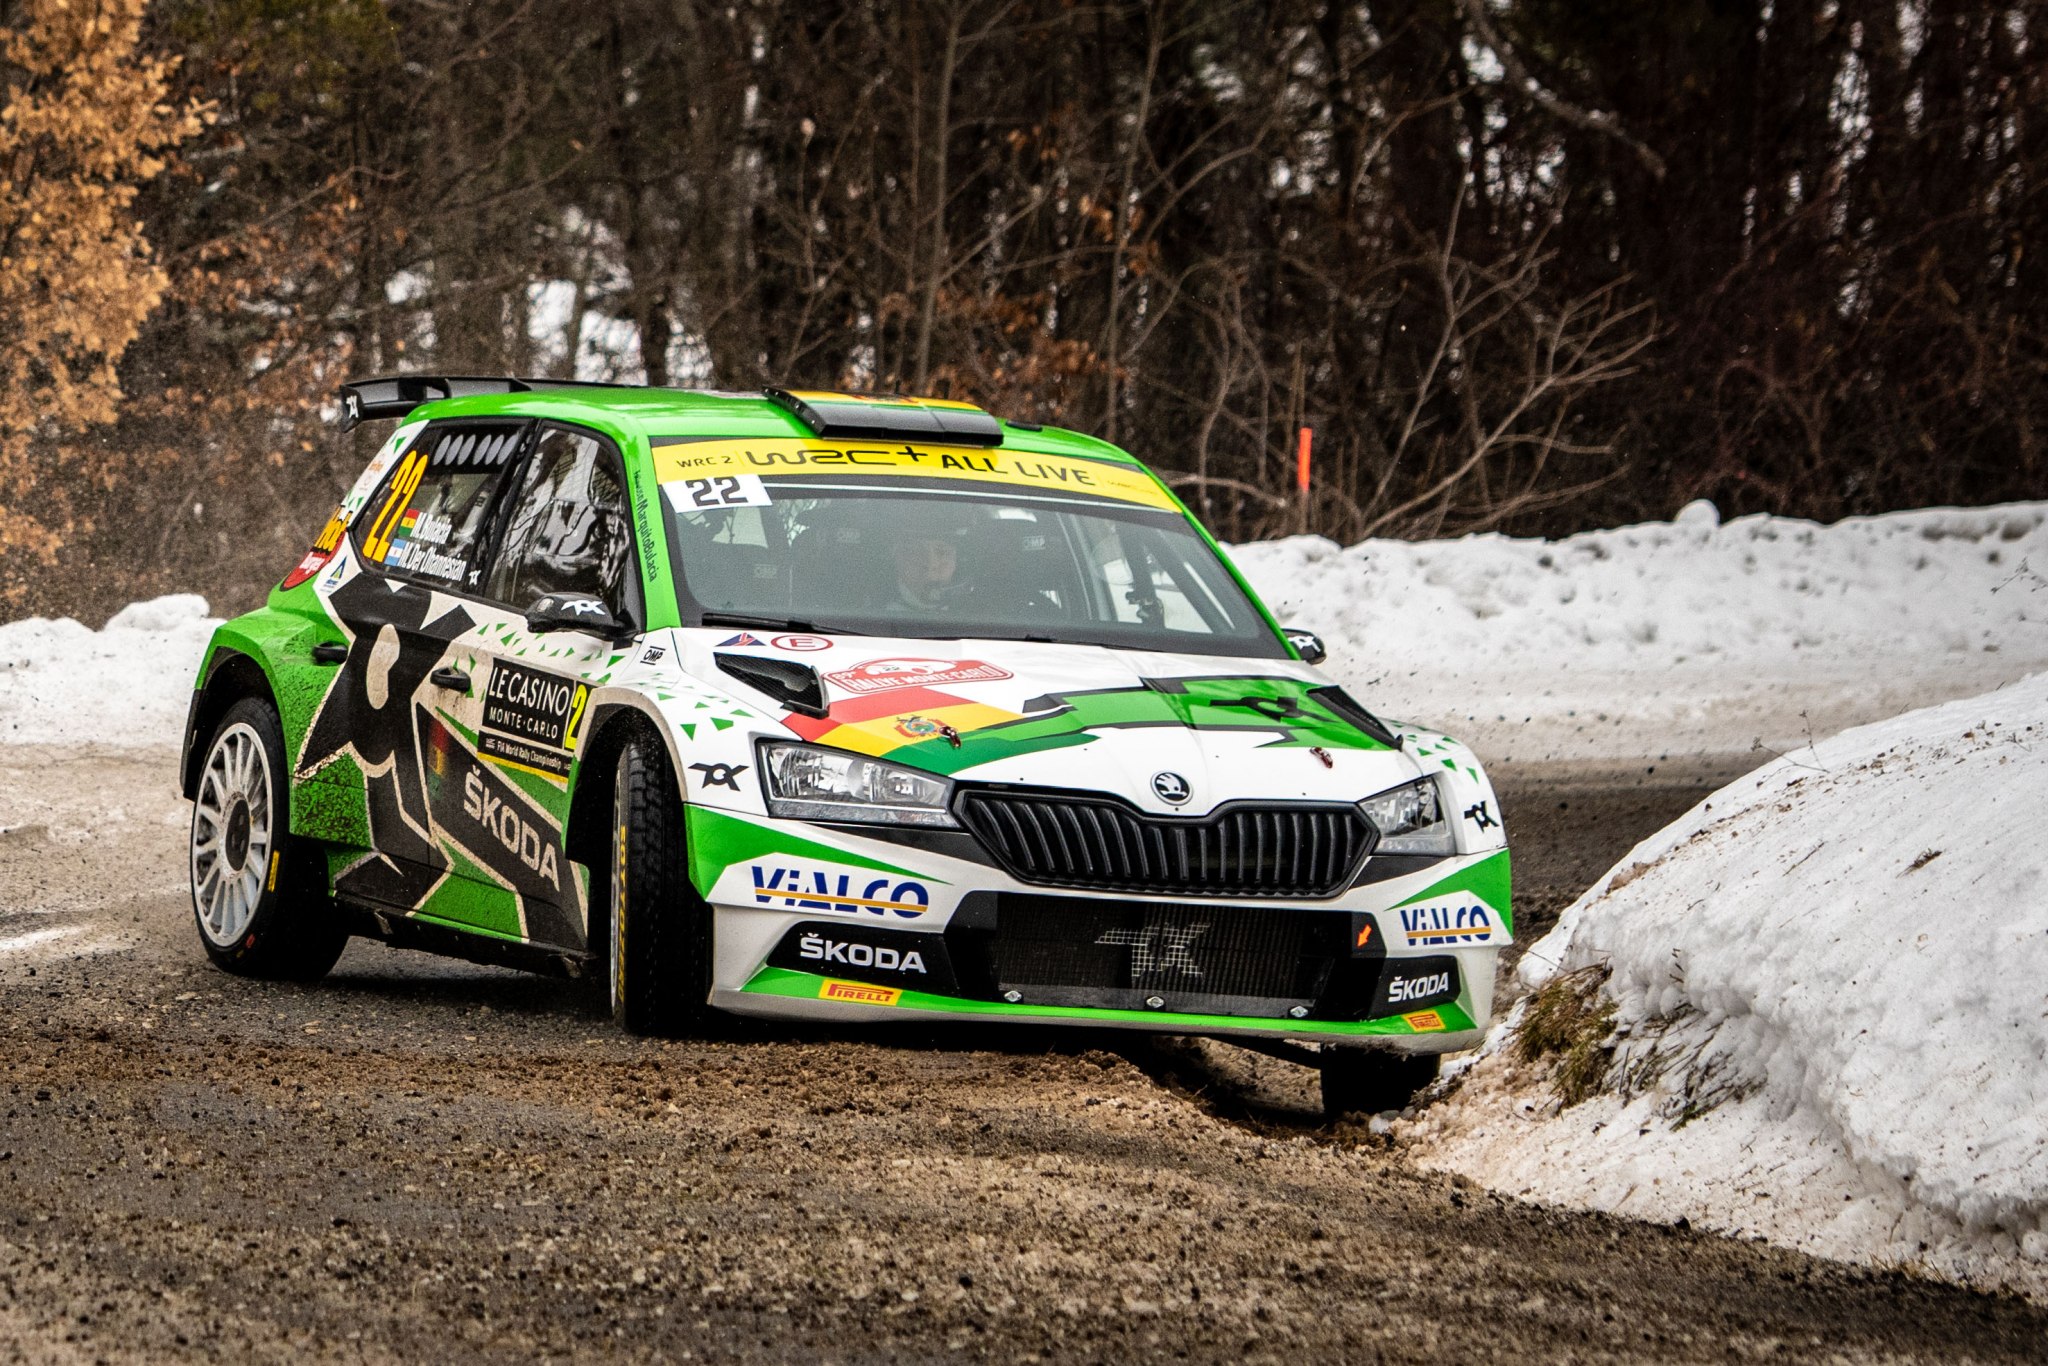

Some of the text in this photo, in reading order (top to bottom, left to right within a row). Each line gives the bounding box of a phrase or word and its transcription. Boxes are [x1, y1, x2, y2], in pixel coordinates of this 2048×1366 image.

[676, 456, 717, 468] WRC
[721, 455, 733, 464] 2
[941, 454, 1008, 474] ALL
[1014, 461, 1096, 486] LIVE
[362, 450, 428, 563] 22
[685, 476, 749, 507] 22
[789, 638, 816, 648] E
[488, 667, 570, 716] LE CASINO
[564, 684, 587, 750] 2
[463, 764, 560, 892] ŠKODA
[800, 933, 927, 974] ŠKODA
[827, 983, 894, 1002] PIRELLI
[1388, 972, 1449, 1003] ŠKODA
